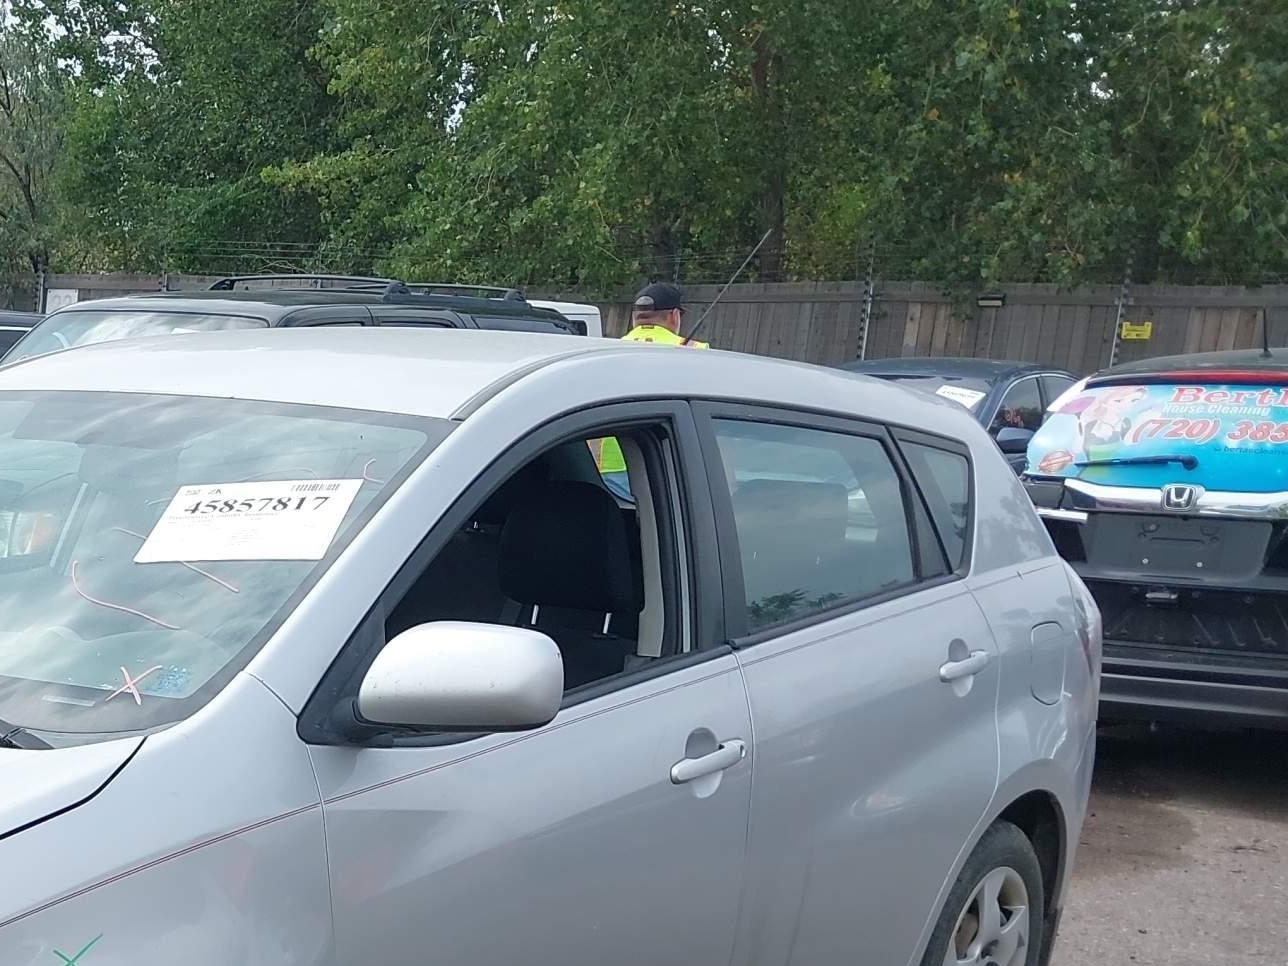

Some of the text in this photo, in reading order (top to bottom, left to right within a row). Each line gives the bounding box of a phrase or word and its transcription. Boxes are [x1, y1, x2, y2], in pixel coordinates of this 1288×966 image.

[1163, 404, 1271, 417] House Cleaning
[1130, 418, 1221, 444] (720)
[184, 496, 332, 515] 45857817
